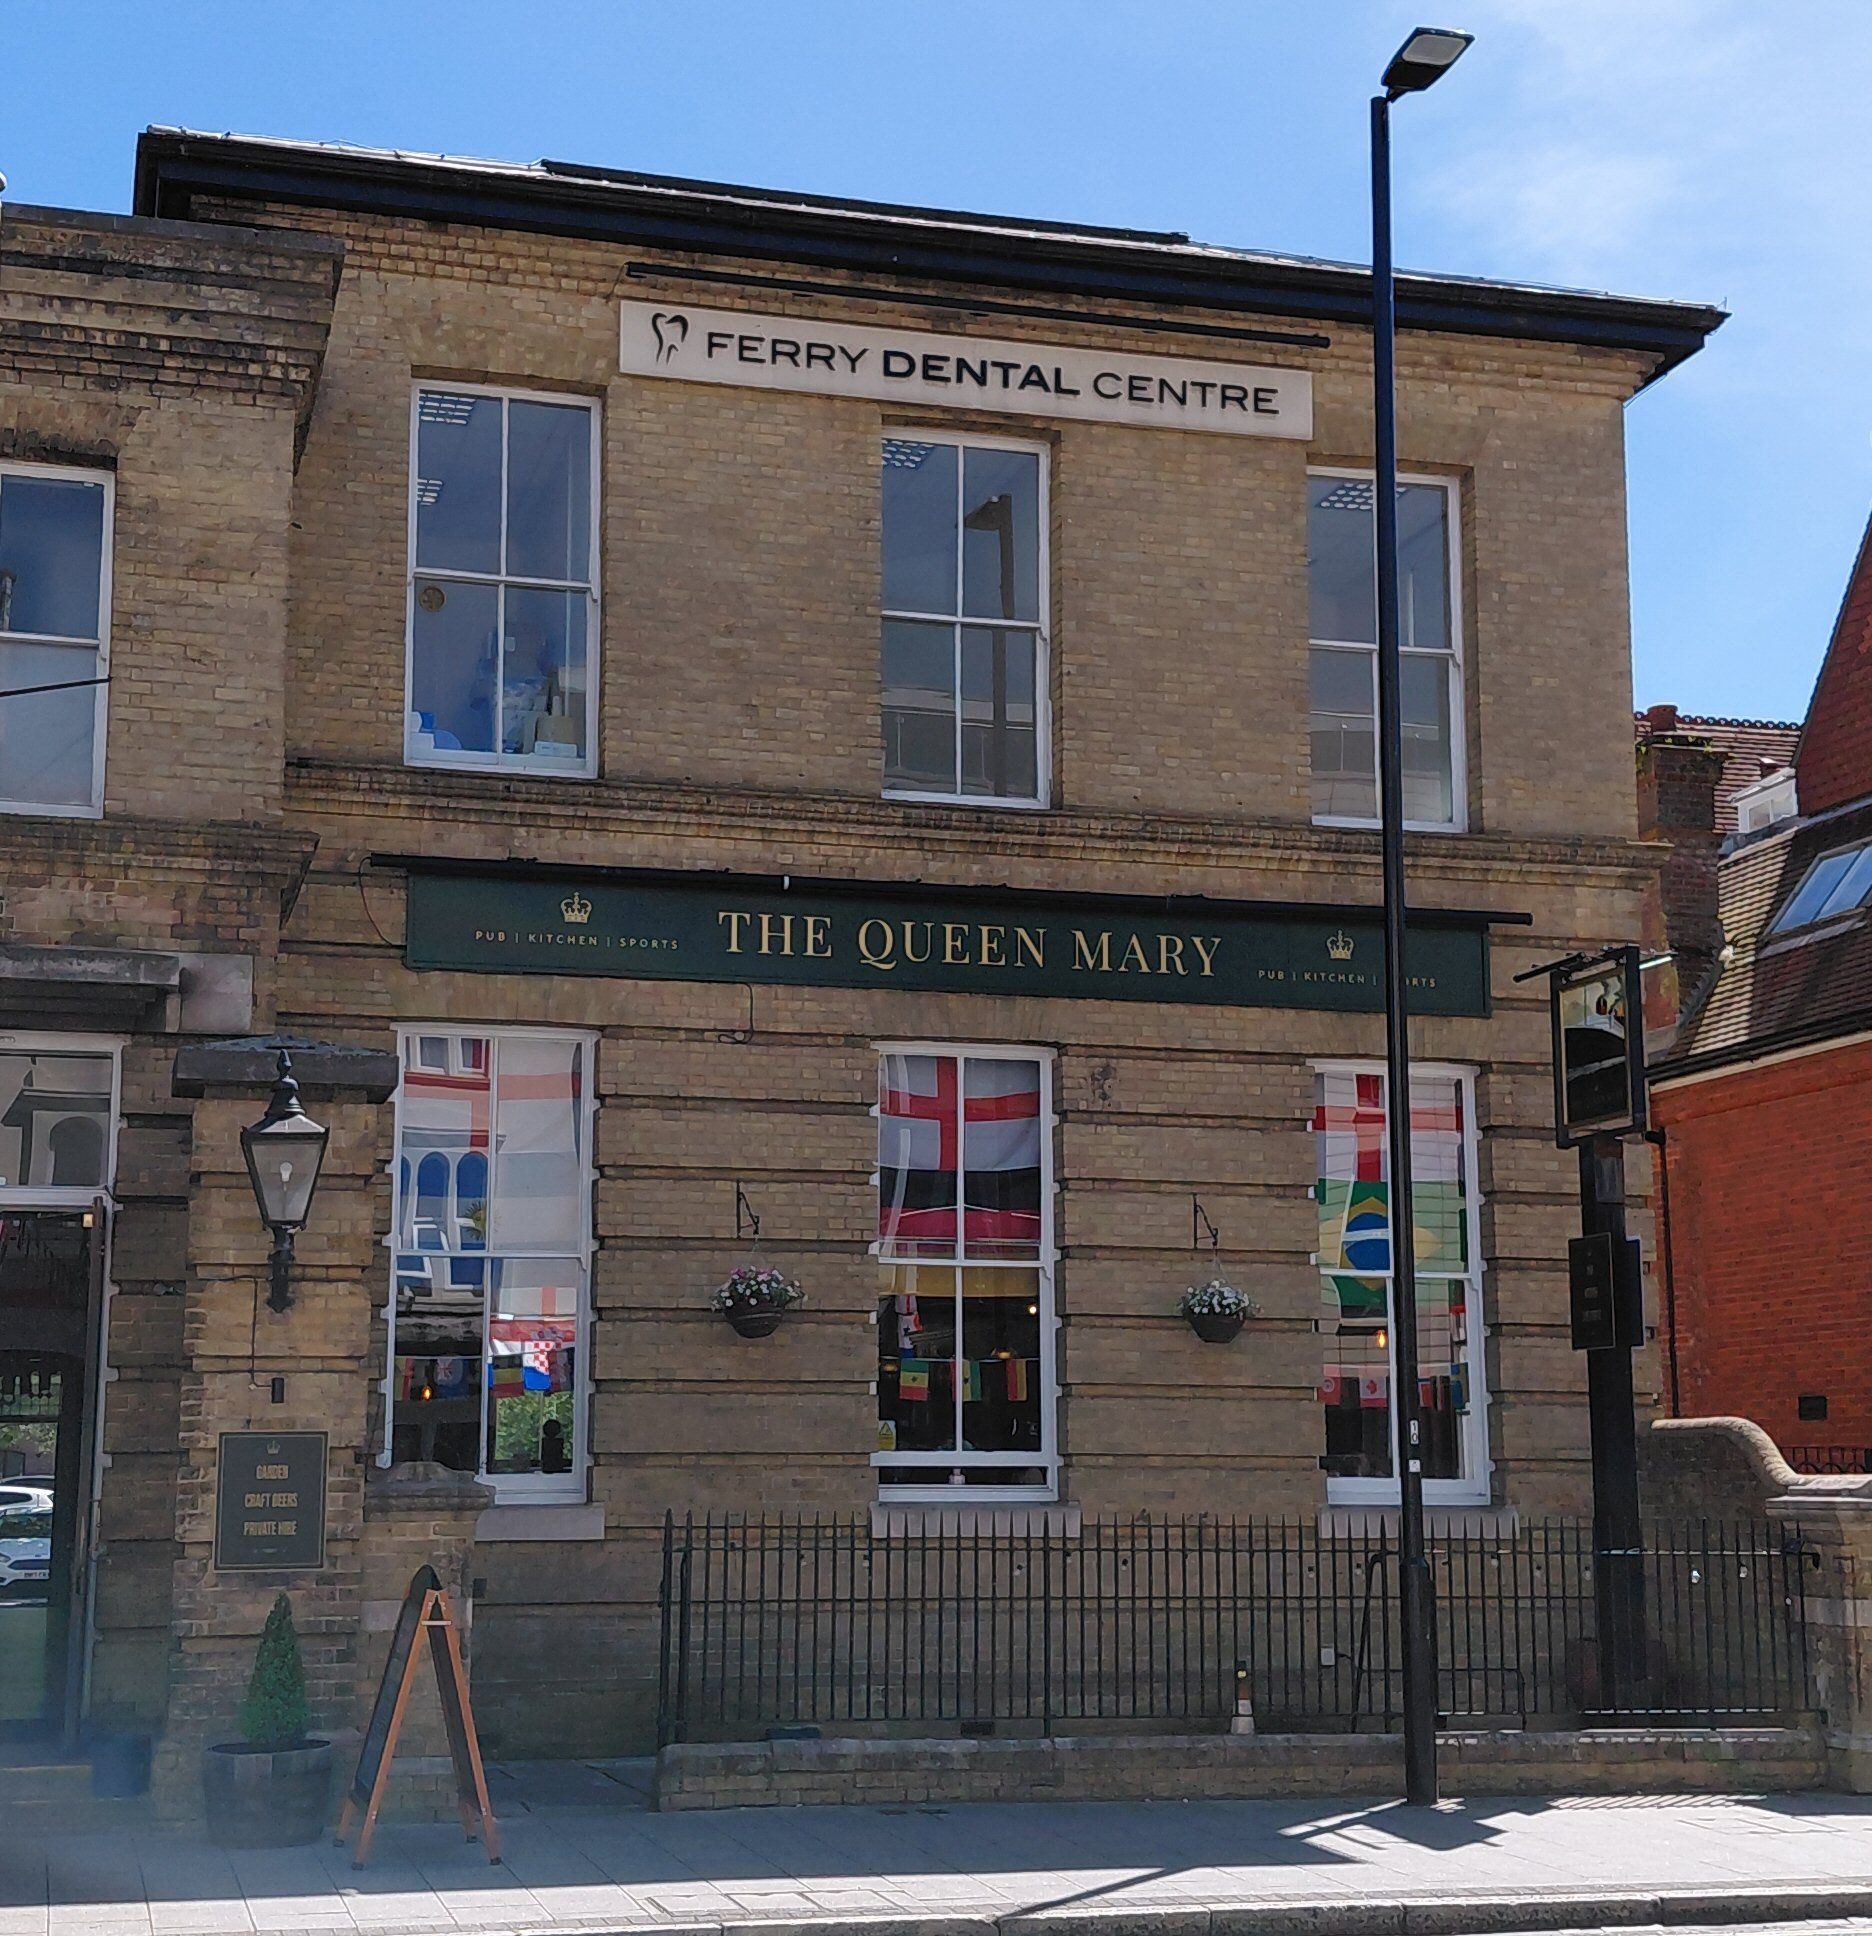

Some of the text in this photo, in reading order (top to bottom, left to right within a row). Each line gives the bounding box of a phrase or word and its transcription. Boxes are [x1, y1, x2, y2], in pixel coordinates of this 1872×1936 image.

[707, 331, 1279, 415] FERRY DENTAL CENTRE
[475, 930, 678, 950] PUB KITCHEN SPORTS
[718, 911, 1222, 977] THE QUEEN MARY
[1258, 970, 1436, 988] PUB KITCHEN RTS
[245, 1492, 298, 1508] CRAFT BEERS
[243, 1521, 277, 1536] PRIVATE
